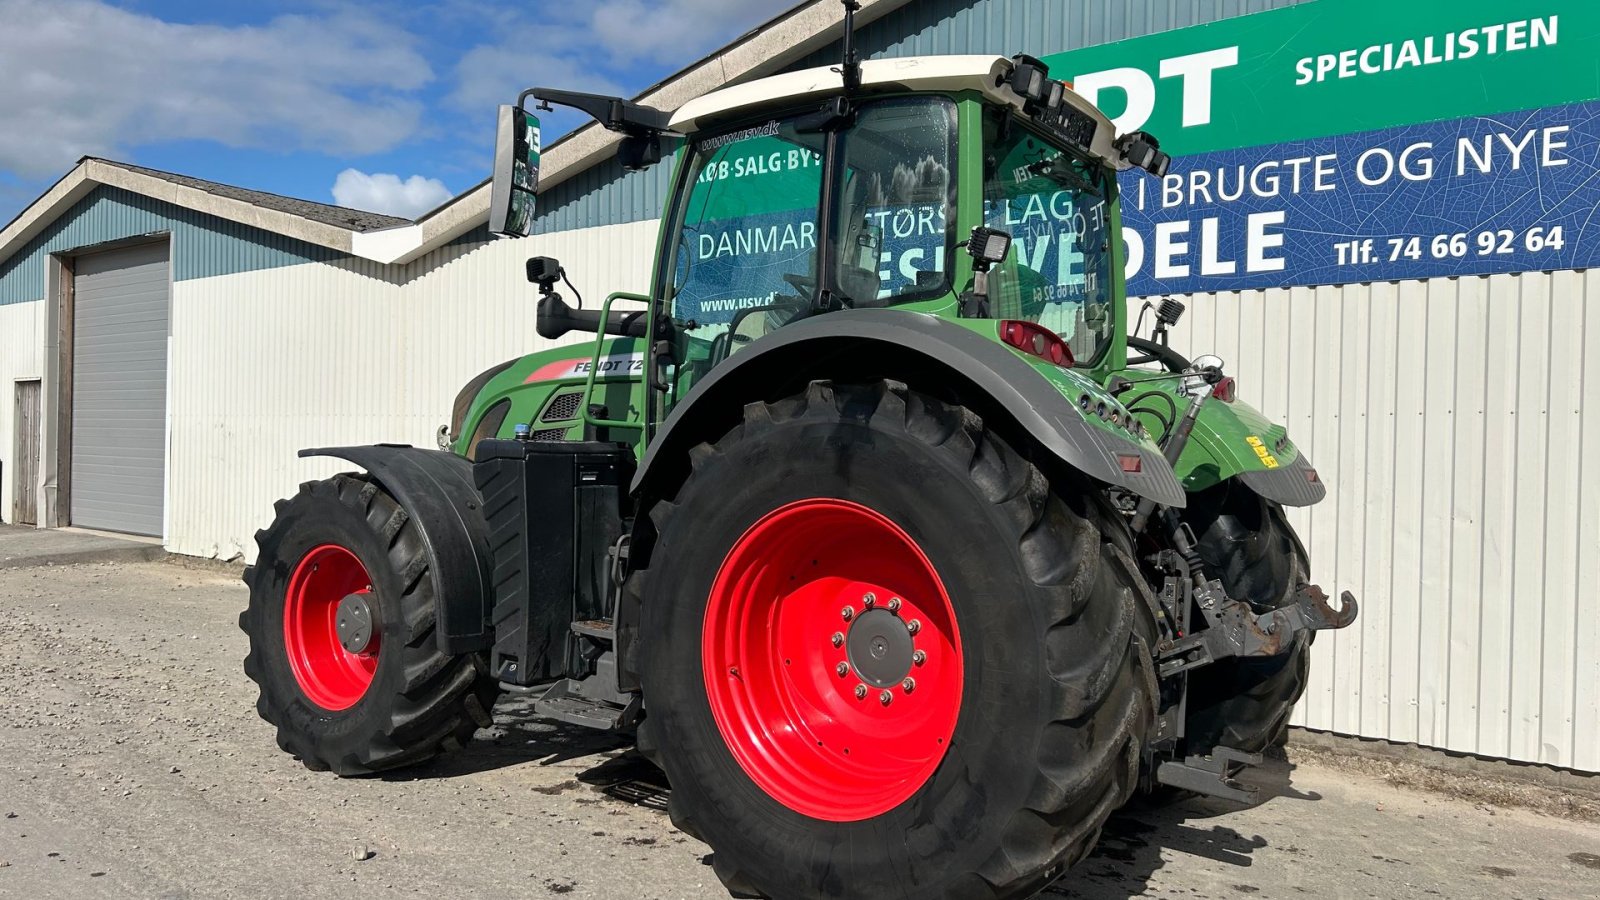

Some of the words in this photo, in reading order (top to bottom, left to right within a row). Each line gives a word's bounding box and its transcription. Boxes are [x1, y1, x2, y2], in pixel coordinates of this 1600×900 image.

[1295, 16, 1557, 85] SPECIALISTEN
[1073, 46, 1239, 134] DT
[702, 120, 780, 151] www.usv.dk
[700, 222, 816, 259] DANMAR
[1005, 190, 1081, 226] LAG
[1162, 154, 1337, 208] BRUGTE
[1356, 143, 1433, 186] OG
[1458, 126, 1569, 176] NYE
[1333, 239, 1378, 266] Tlf.
[1387, 237, 1422, 262] 74
[1431, 233, 1467, 258] 66
[1477, 230, 1514, 256] 92
[1525, 226, 1565, 252] 64
[700, 291, 778, 312] www.usv.d
[626, 360, 643, 371] 72
